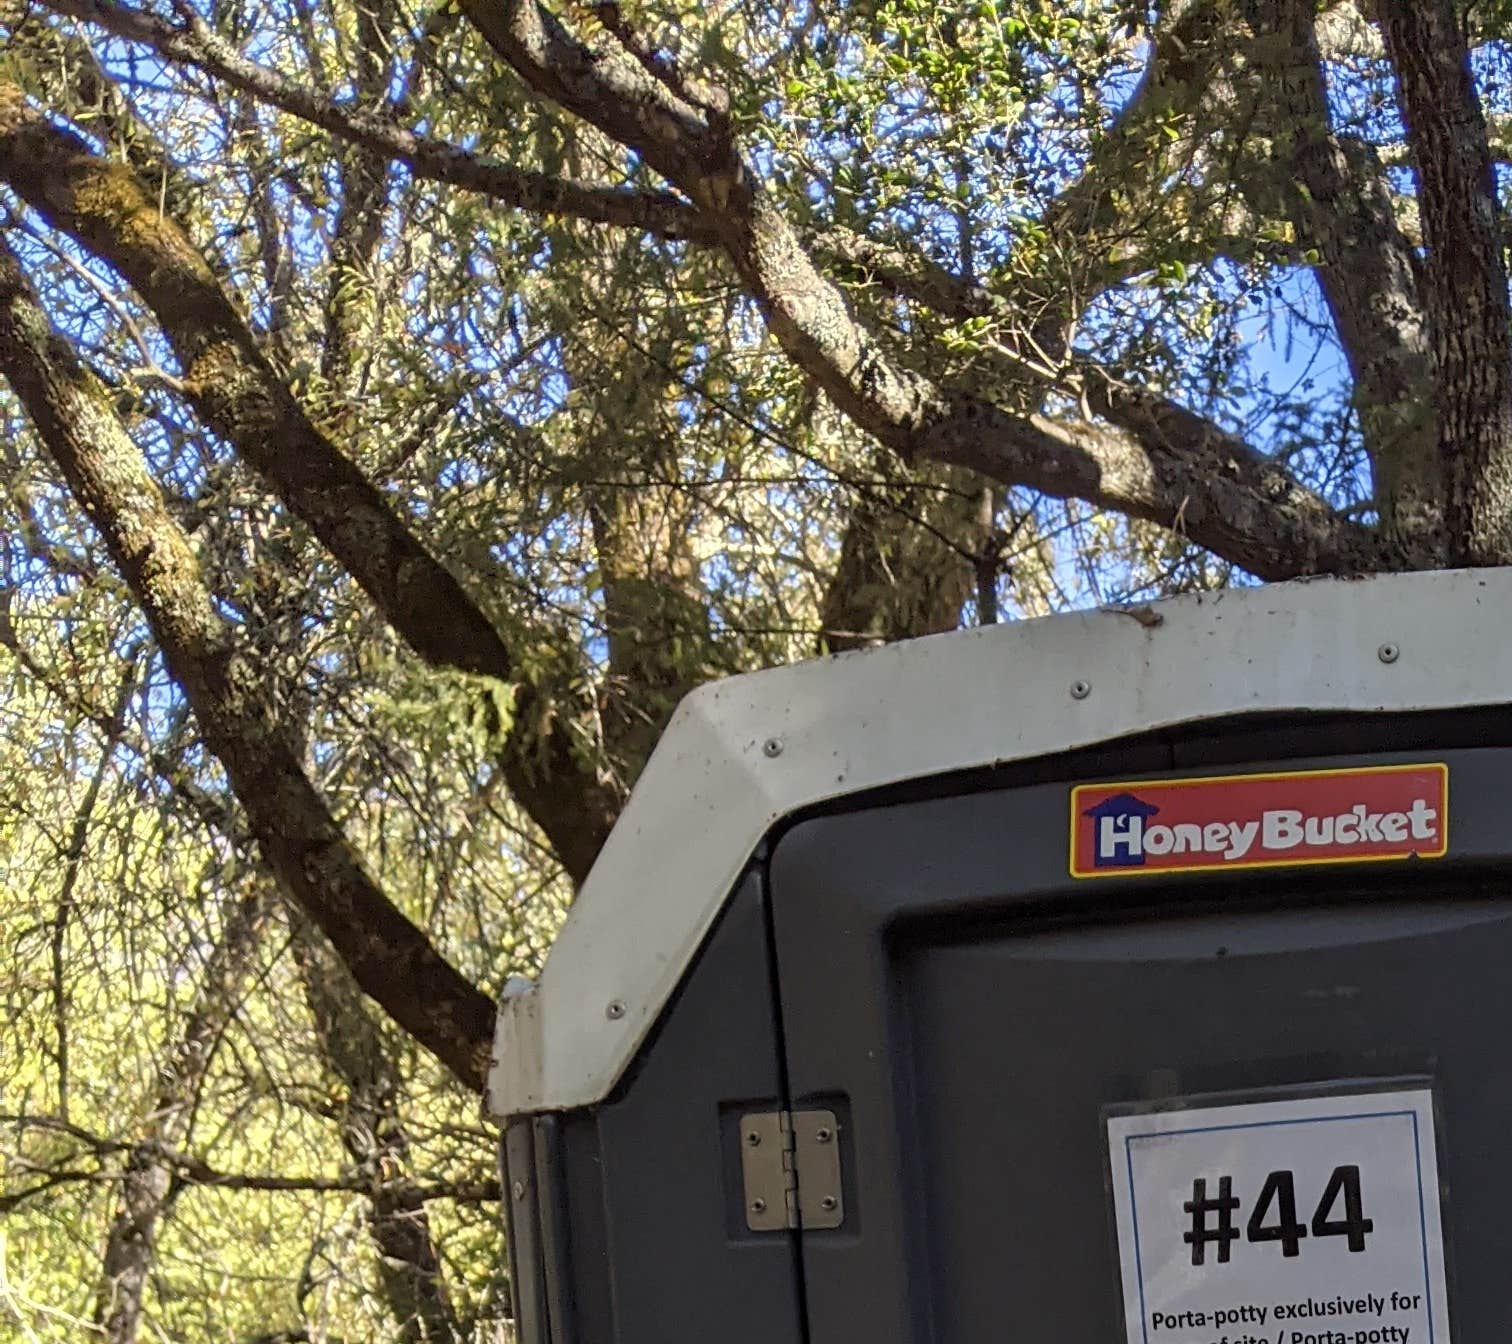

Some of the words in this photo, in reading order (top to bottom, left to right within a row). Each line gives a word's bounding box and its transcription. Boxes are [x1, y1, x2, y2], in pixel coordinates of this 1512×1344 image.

[1183, 1165, 1373, 1266] #44
[1152, 1305, 1267, 1330] Porta-potty
[1273, 1293, 1384, 1320] exclusively
[1390, 1291, 1421, 1311] for
